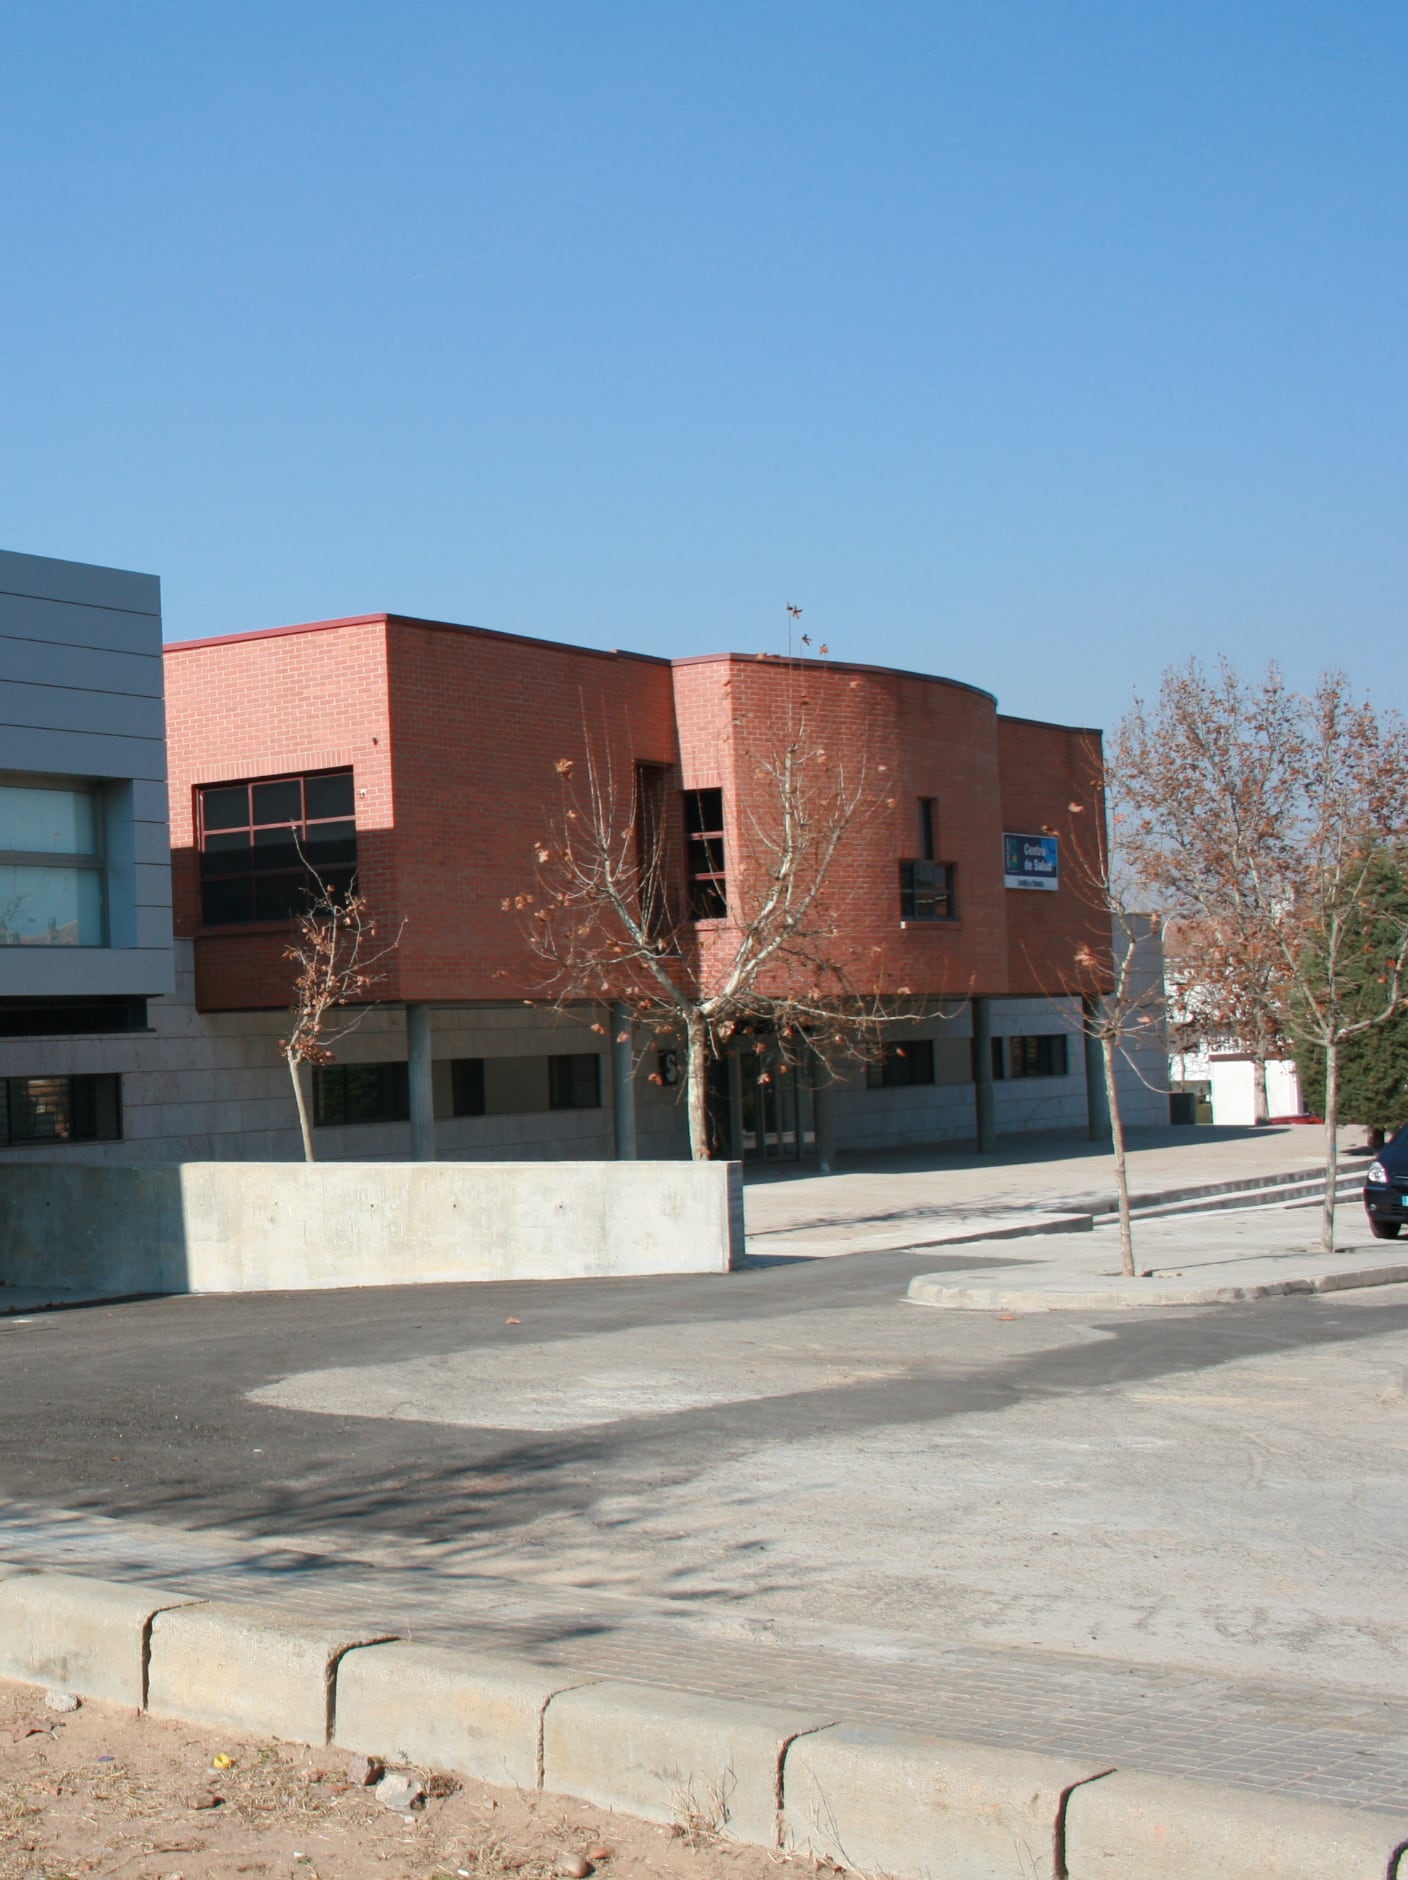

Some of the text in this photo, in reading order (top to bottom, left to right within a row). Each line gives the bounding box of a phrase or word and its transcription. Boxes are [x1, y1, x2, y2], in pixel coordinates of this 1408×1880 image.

[1023, 843, 1048, 857] Centro
[1023, 858, 1053, 872] de Salud
